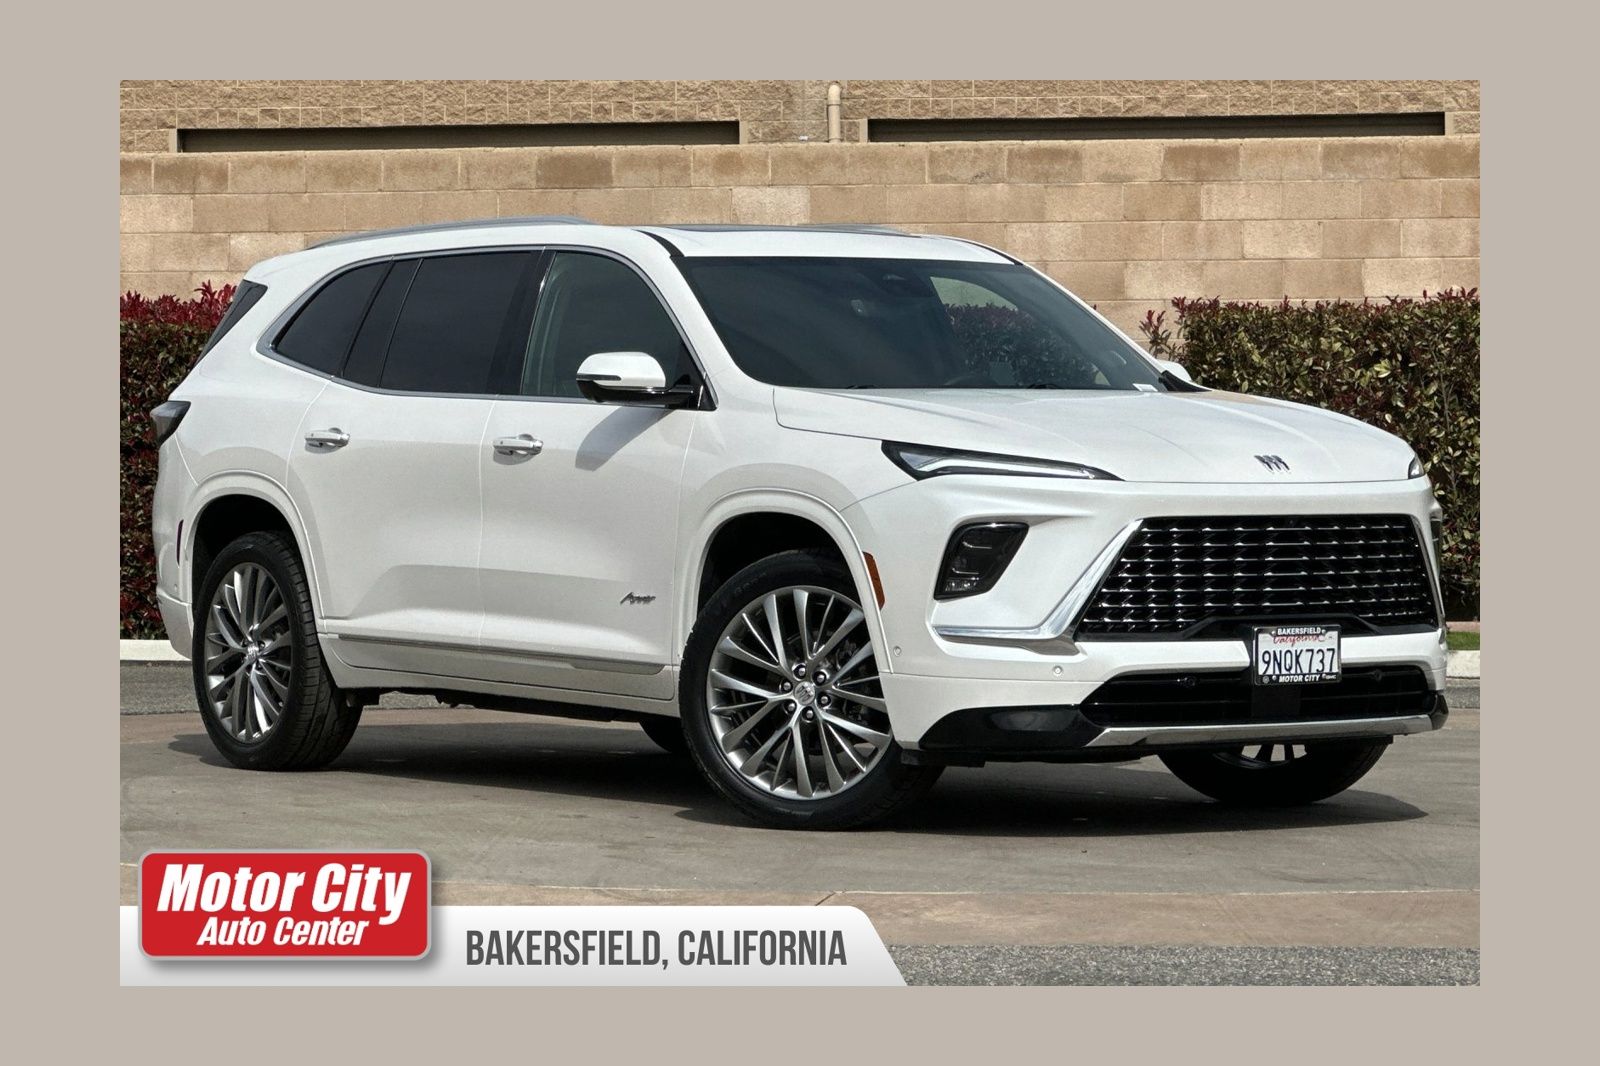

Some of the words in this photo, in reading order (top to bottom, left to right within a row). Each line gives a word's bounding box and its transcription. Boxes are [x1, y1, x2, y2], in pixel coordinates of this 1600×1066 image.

[1277, 627, 1321, 635] BAKERSFIELD
[1262, 648, 1336, 675] 9NQK737
[1279, 675, 1303, 683] MOTOR
[1304, 674, 1321, 682] CITY
